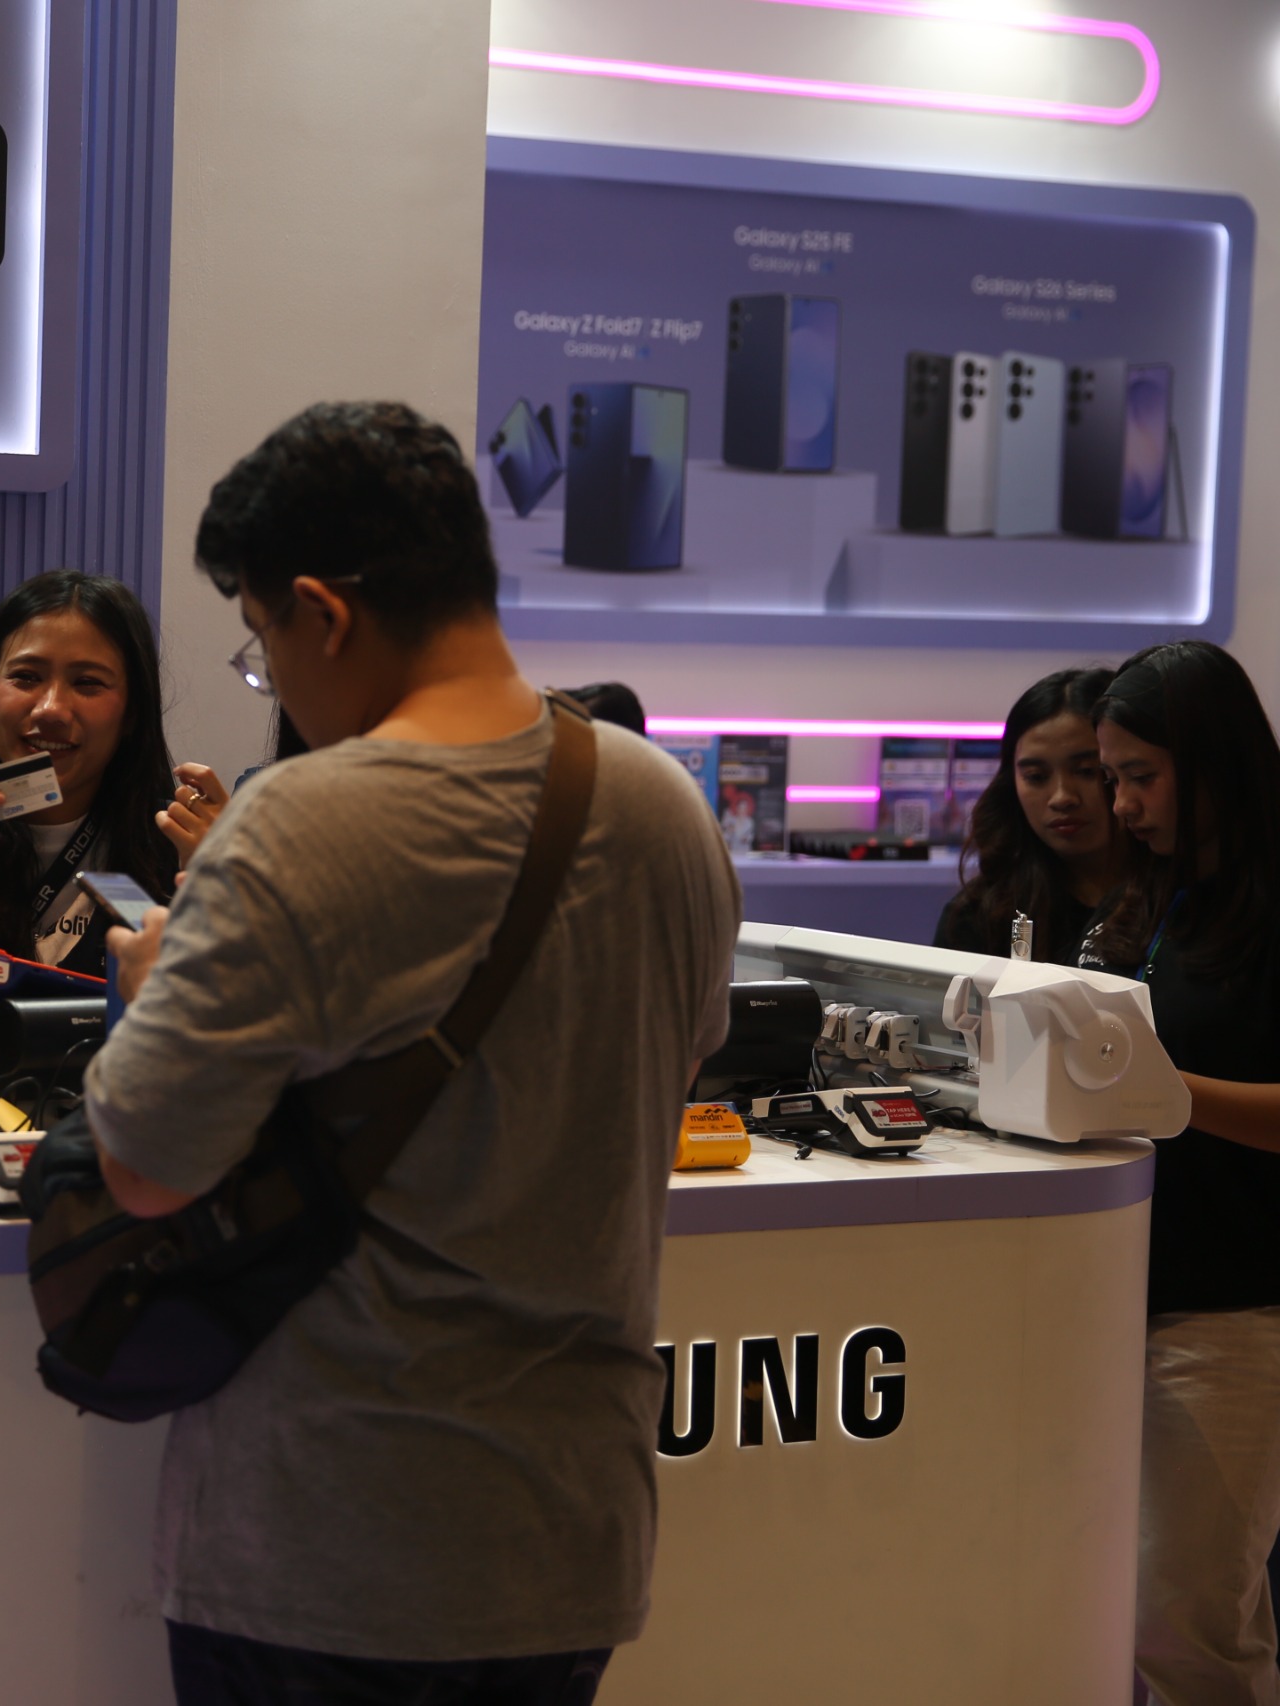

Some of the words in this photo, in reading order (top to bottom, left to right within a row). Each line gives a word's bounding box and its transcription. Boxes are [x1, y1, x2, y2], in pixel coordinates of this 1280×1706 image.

[734, 225, 800, 254] Galaxy
[971, 275, 1034, 303] Galaxy
[514, 310, 579, 337] Galaxy
[581, 314, 594, 334] Z
[595, 315, 643, 336] Fold7
[663, 318, 703, 345] Flip7
[563, 339, 619, 362] Galaxy
[653, 1326, 907, 1457] UNG
